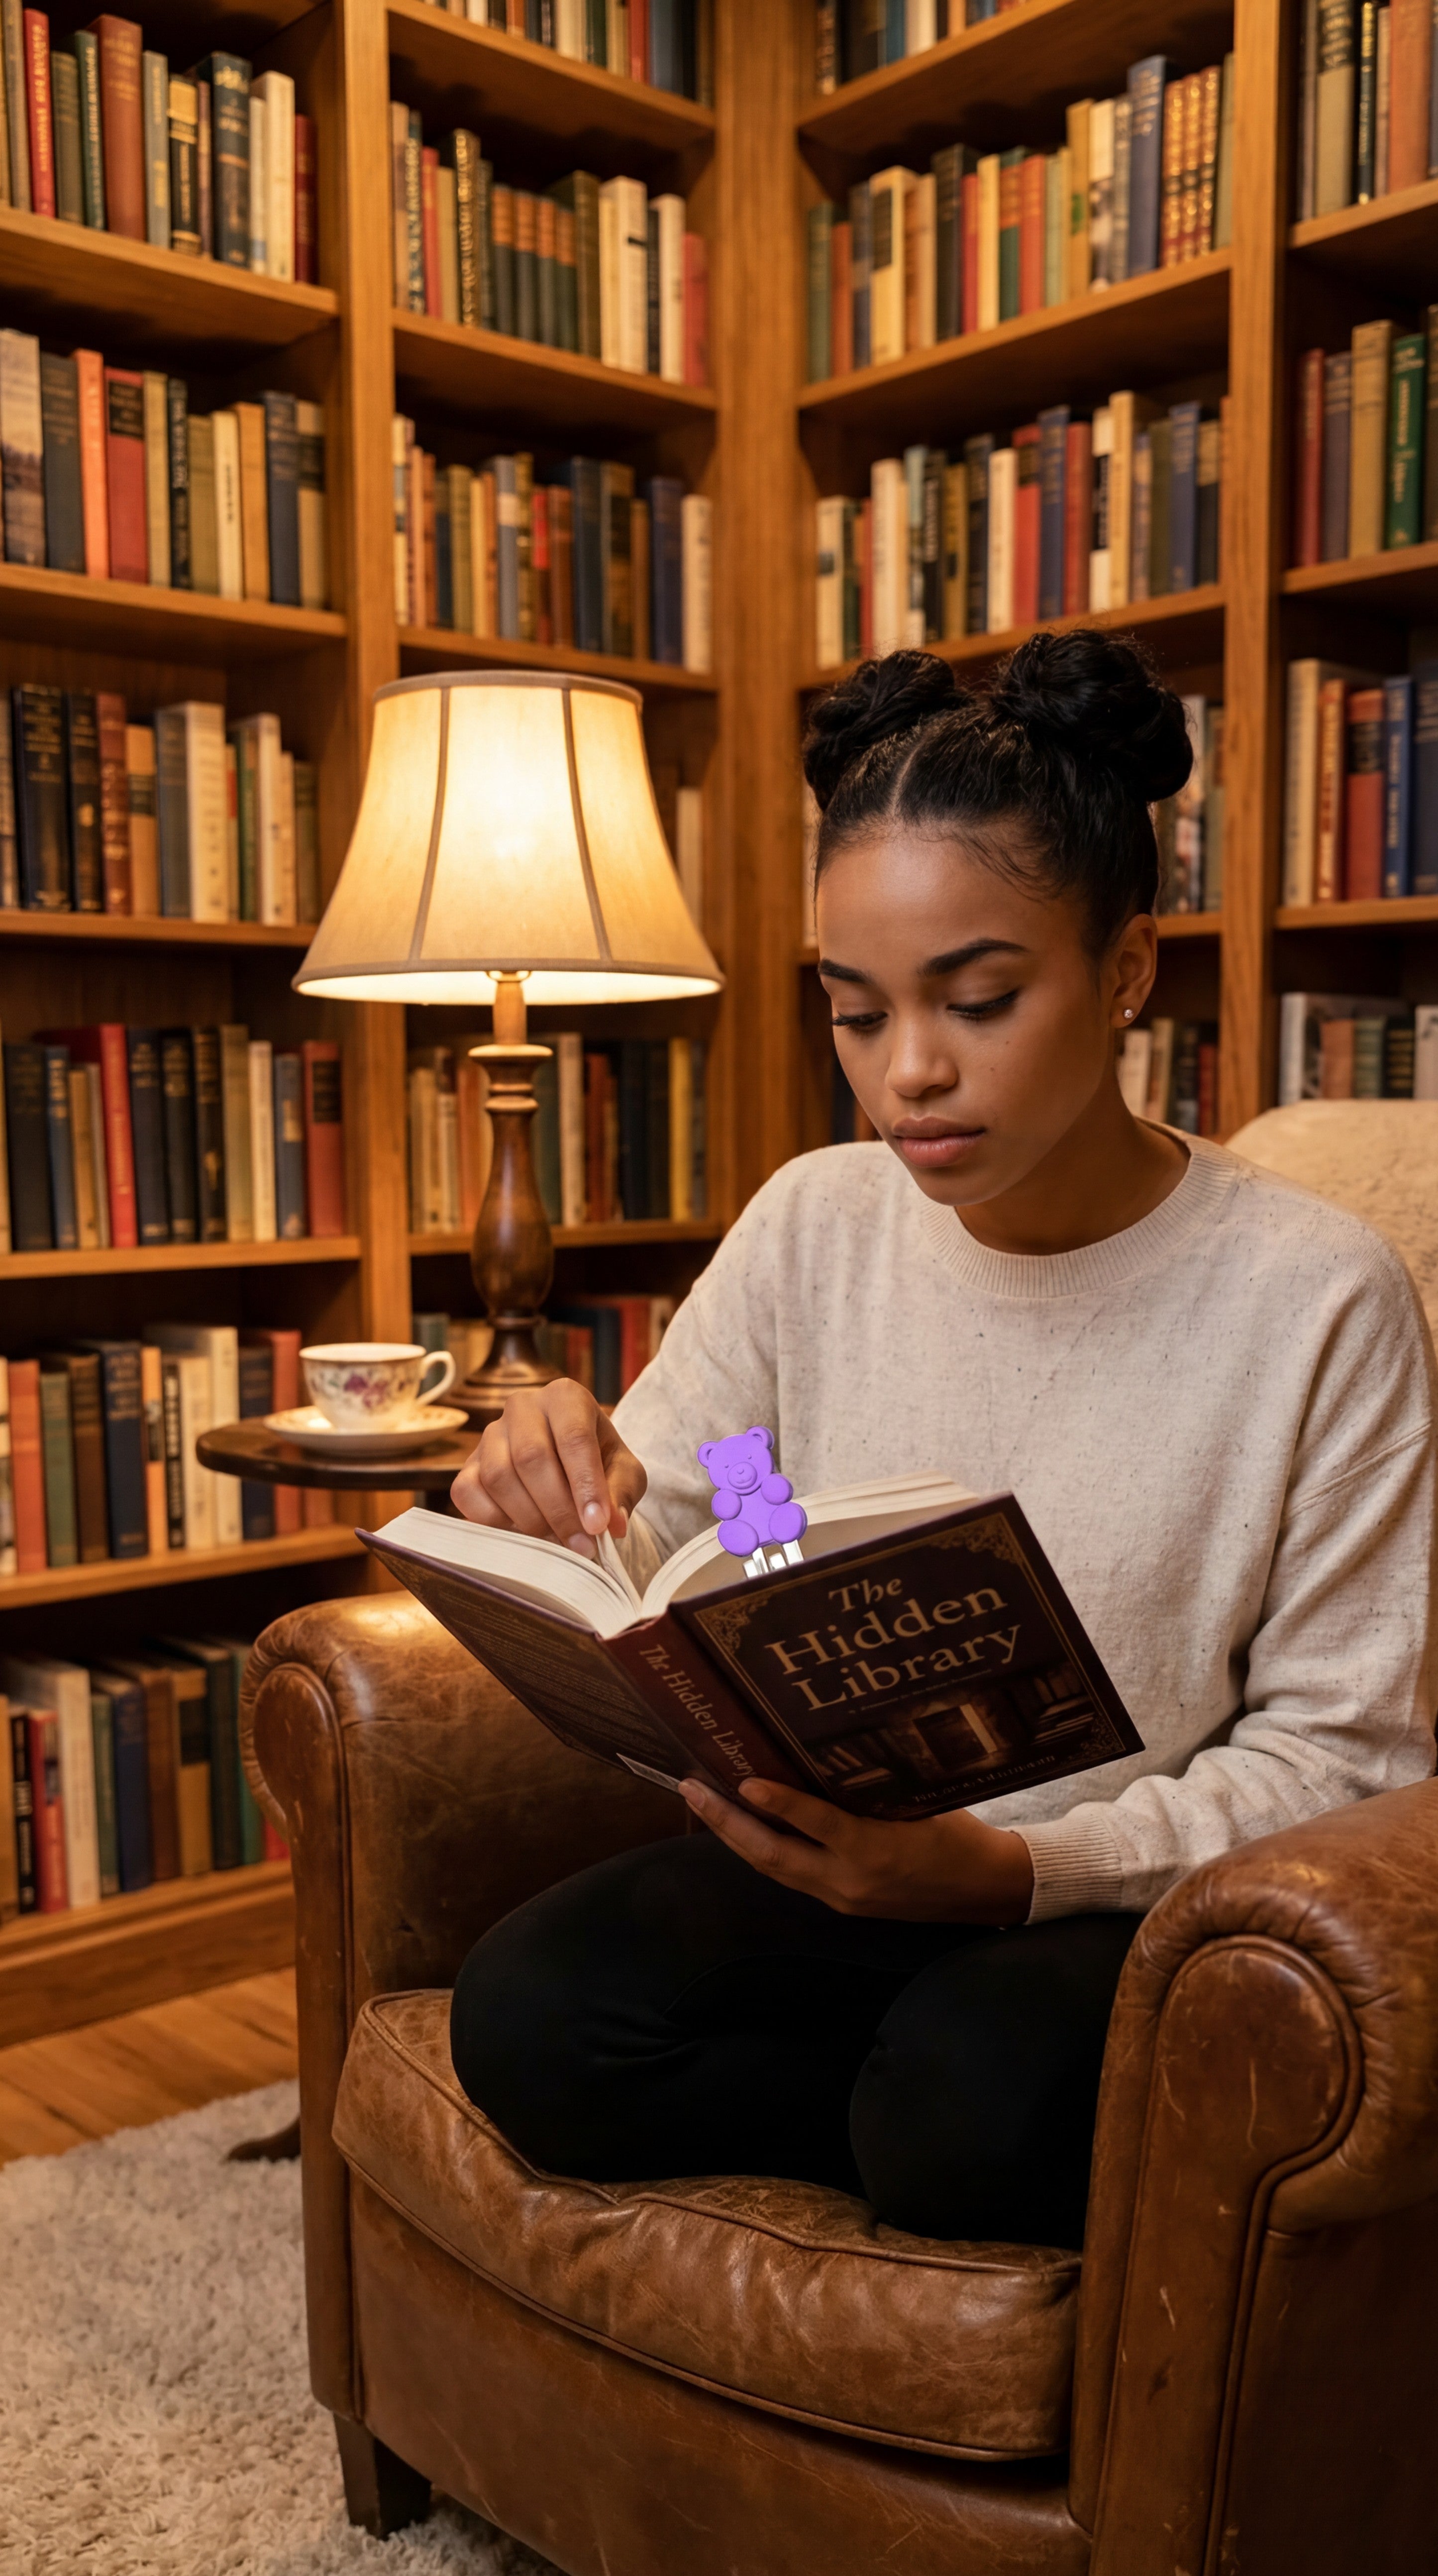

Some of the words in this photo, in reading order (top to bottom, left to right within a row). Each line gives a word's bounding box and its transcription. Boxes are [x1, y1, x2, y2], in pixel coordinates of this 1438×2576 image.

[764, 1588, 1008, 1675] Hidden
[828, 1578, 902, 1613] The
[639, 1644, 670, 1670] The
[662, 1670, 718, 1731] Hidden
[712, 1731, 757, 1776] Library
[791, 1624, 1021, 1711] Library
